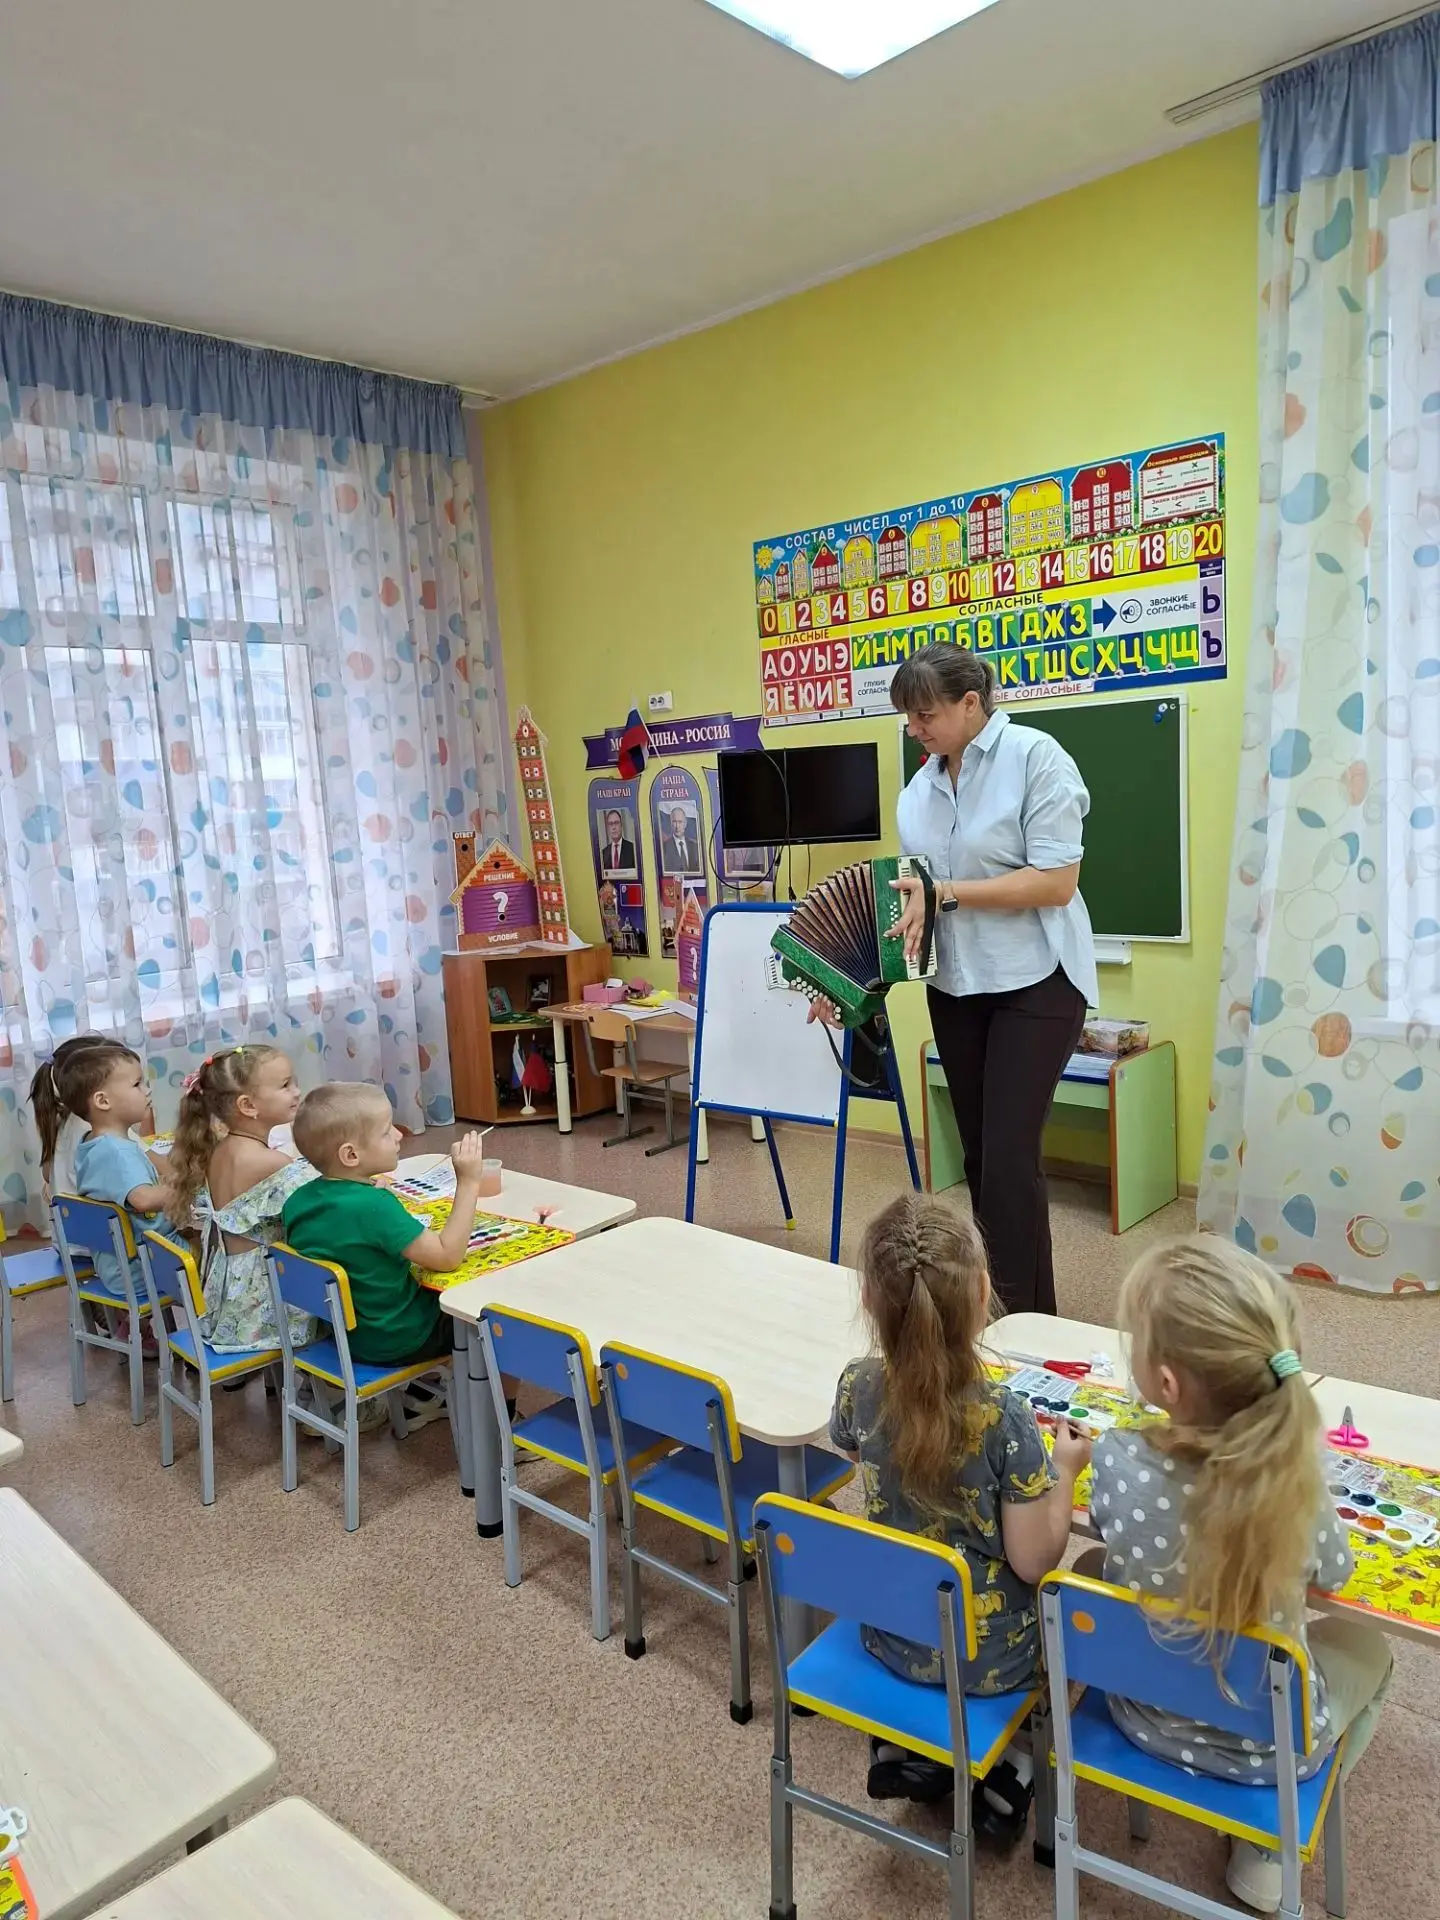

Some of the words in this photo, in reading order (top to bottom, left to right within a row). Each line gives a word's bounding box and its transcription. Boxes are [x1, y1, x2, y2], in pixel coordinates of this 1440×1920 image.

[785, 527, 836, 549] СОСТАВ
[844, 514, 890, 535] ЧИСЕЛ
[900, 511, 913, 523] от
[917, 507, 922, 518] 1
[929, 505, 946, 518] до
[950, 496, 965, 511] 10
[763, 608, 777, 632] 0
[781, 605, 791, 630] 1
[797, 602, 811, 628] 2
[816, 598, 829, 624] 3
[832, 595, 846, 620] 4
[853, 590, 866, 618] 5
[870, 588, 886, 614] 6
[891, 584, 905, 611] 7
[911, 580, 927, 607] 8
[931, 576, 947, 603] 9
[950, 571, 970, 600] 10
[972, 567, 990, 596] 11
[994, 563, 1016, 592] 12
[1016, 558, 1040, 588] 13
[1042, 553, 1064, 584] 14
[1066, 550, 1089, 580] 15
[1090, 544, 1114, 575] 16
[1114, 539, 1139, 570] 17
[1140, 534, 1165, 566] 18
[1168, 528, 1194, 562] 19
[1195, 523, 1222, 557] 20
[958, 593, 1044, 616] СОГЛАСНЫЕ
[1150, 594, 1189, 606] ЗВОНКИЕ
[1202, 585, 1220, 614] Ь
[1146, 601, 1197, 616] СОГЛАСНЫЕ
[779, 628, 830, 646] ГЛАСНЫЕ
[1202, 630, 1222, 658] Ъ
[858, 687, 891, 696] СОГЛАСНЫ
[1014, 683, 1082, 699] СОГЛАСНЫЕ
[685, 724, 731, 744] РОССИЯ
[660, 788, 689, 799] СТРАНА
[454, 831, 474, 839] ОТВЕТ
[483, 872, 515, 881] РЕШЕНИЕ
[488, 932, 519, 943] УСЛОВИЕ
